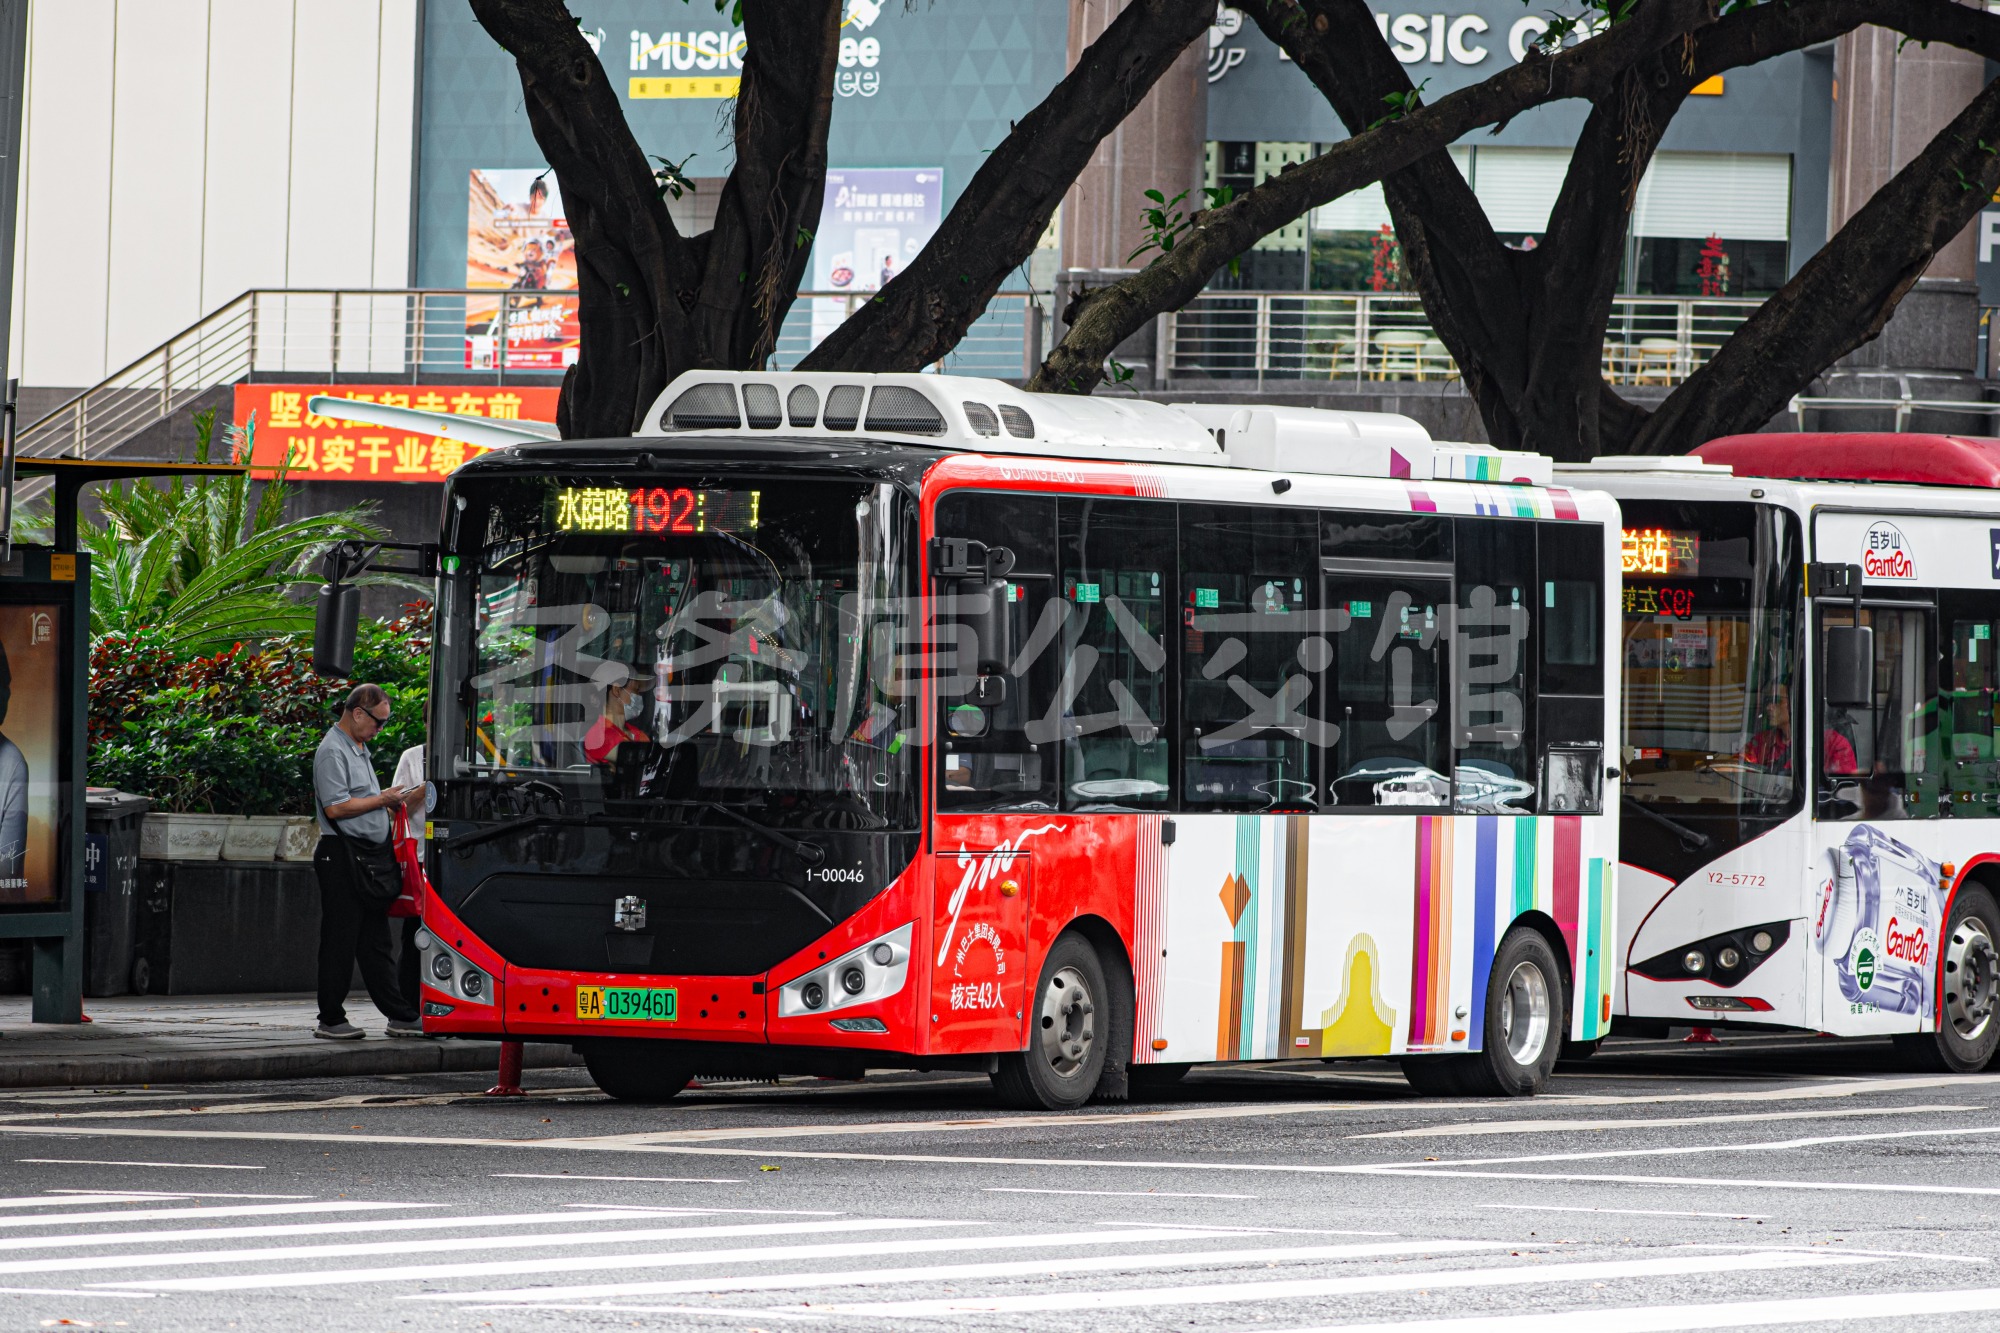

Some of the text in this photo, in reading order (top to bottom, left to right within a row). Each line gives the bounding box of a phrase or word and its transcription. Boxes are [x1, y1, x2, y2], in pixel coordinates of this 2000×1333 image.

[556, 487, 629, 531] 水荫路
[630, 488, 695, 532] 192
[1869, 530, 1901, 550] 百岁山
[806, 868, 864, 883] 1-00046
[1708, 872, 1766, 887] Y2-5772
[954, 922, 1006, 978] 广州巴士集团有限公司
[950, 982, 1005, 1010] 核定43人
